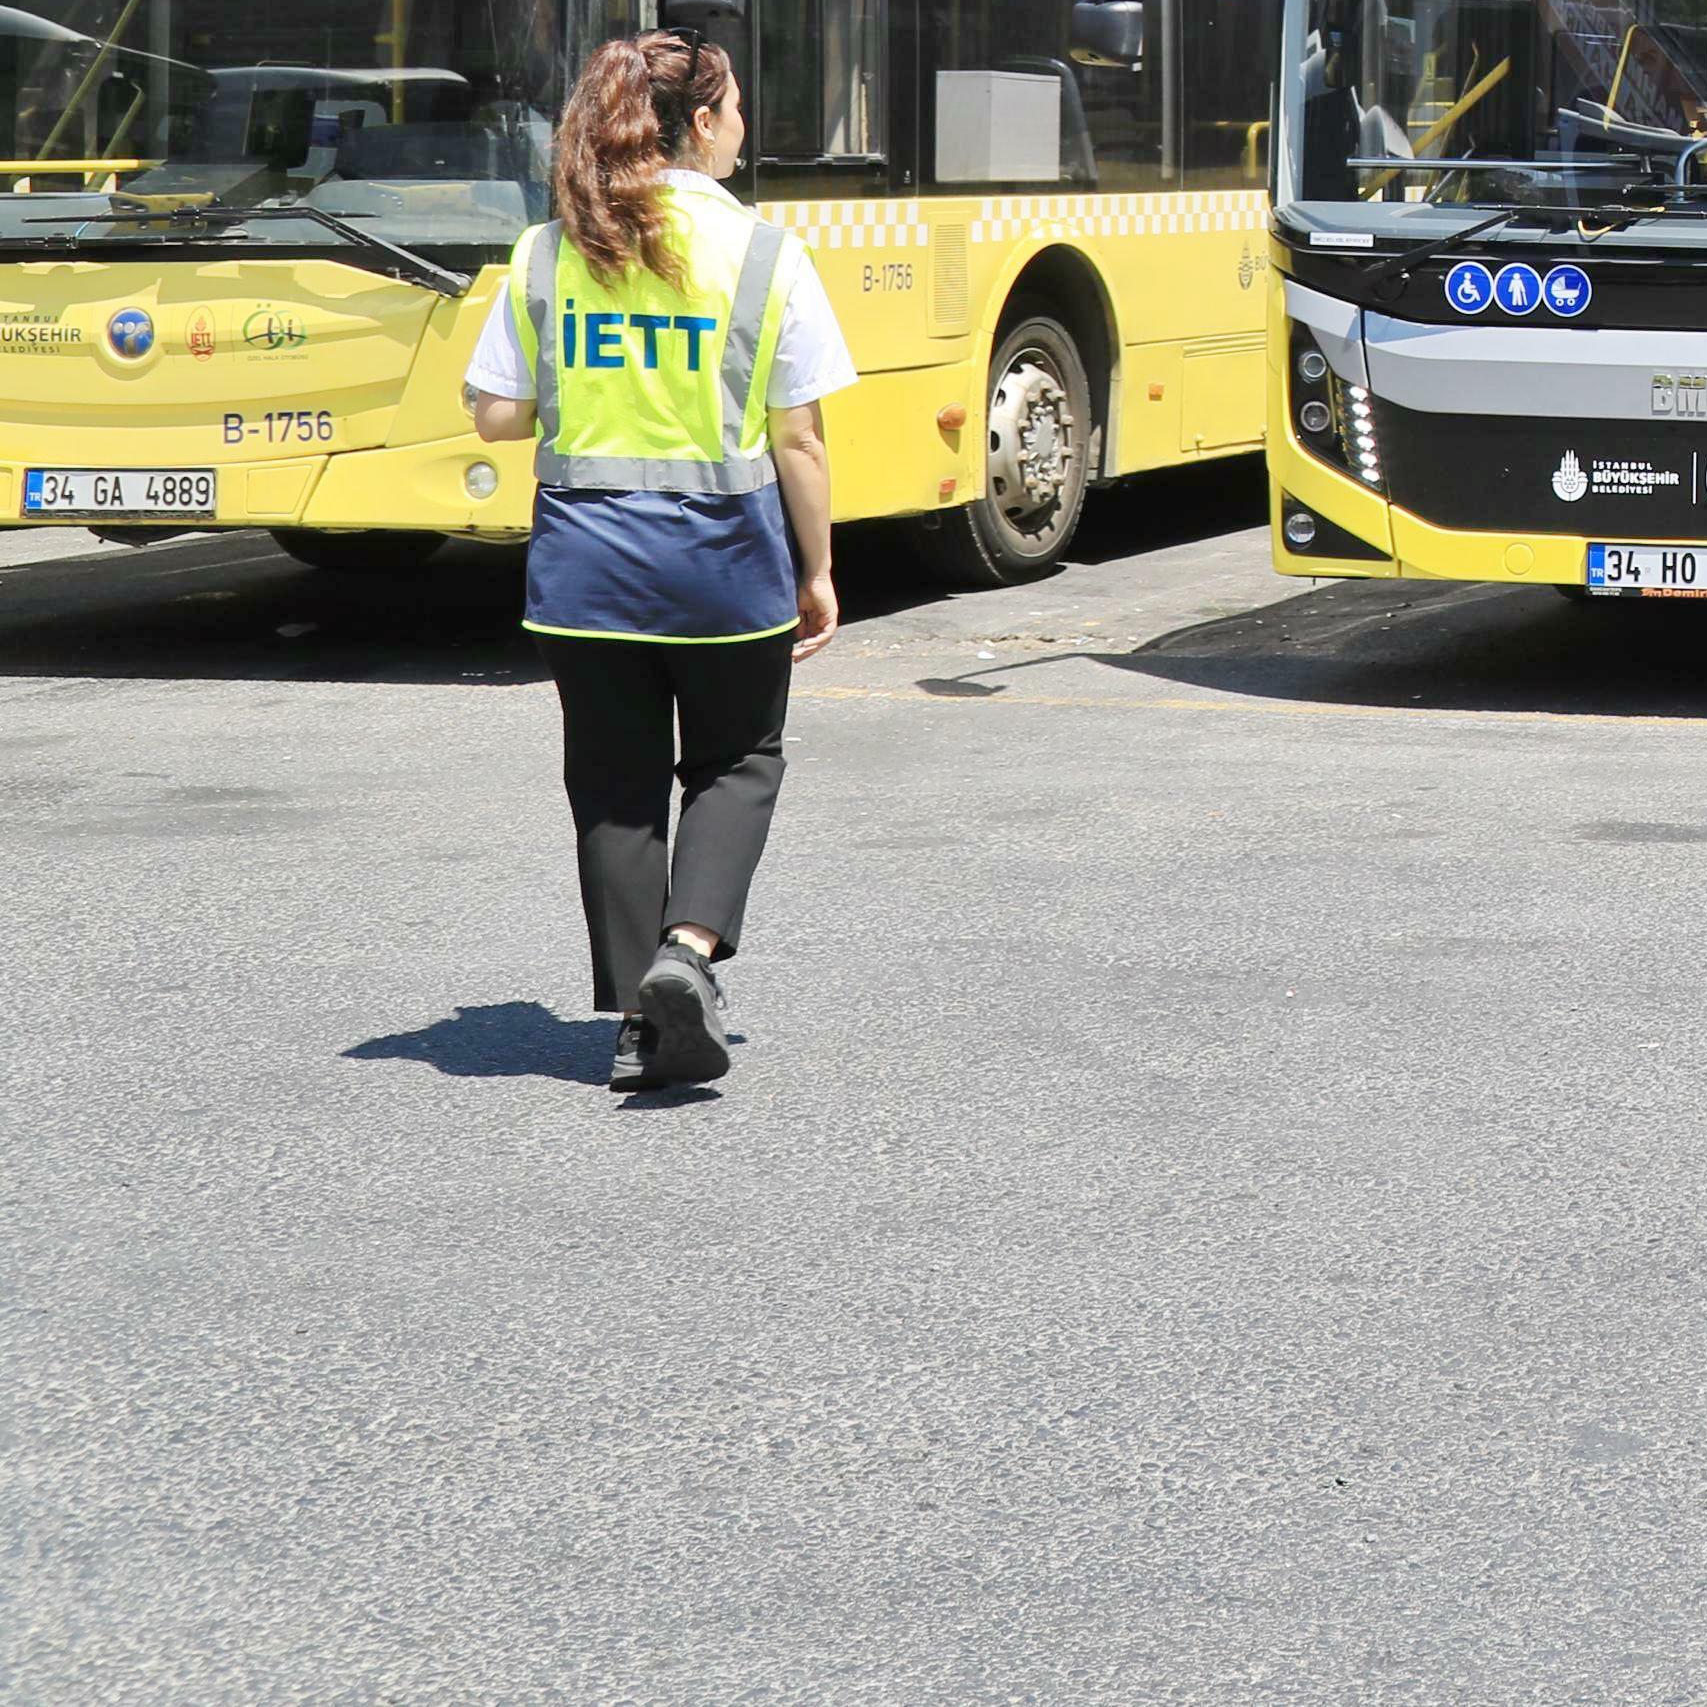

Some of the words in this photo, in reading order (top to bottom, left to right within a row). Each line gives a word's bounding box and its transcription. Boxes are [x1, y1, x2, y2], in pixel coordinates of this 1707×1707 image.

[863, 264, 912, 292] B-1756
[563, 298, 717, 371] İETT
[224, 411, 333, 444] B-1756
[1593, 460, 1653, 470] İSTANBUL
[1593, 470, 1679, 485] BÜYÜKŞEHİR
[29, 492, 41, 502] TR
[44, 476, 74, 506] 34
[94, 476, 124, 507] GA
[146, 475, 211, 506] 4889
[1592, 485, 1653, 494] BELEDİYESİ
[1591, 568, 1604, 578] TR
[1607, 550, 1640, 582] 34
[1662, 552, 1696, 584] HO
